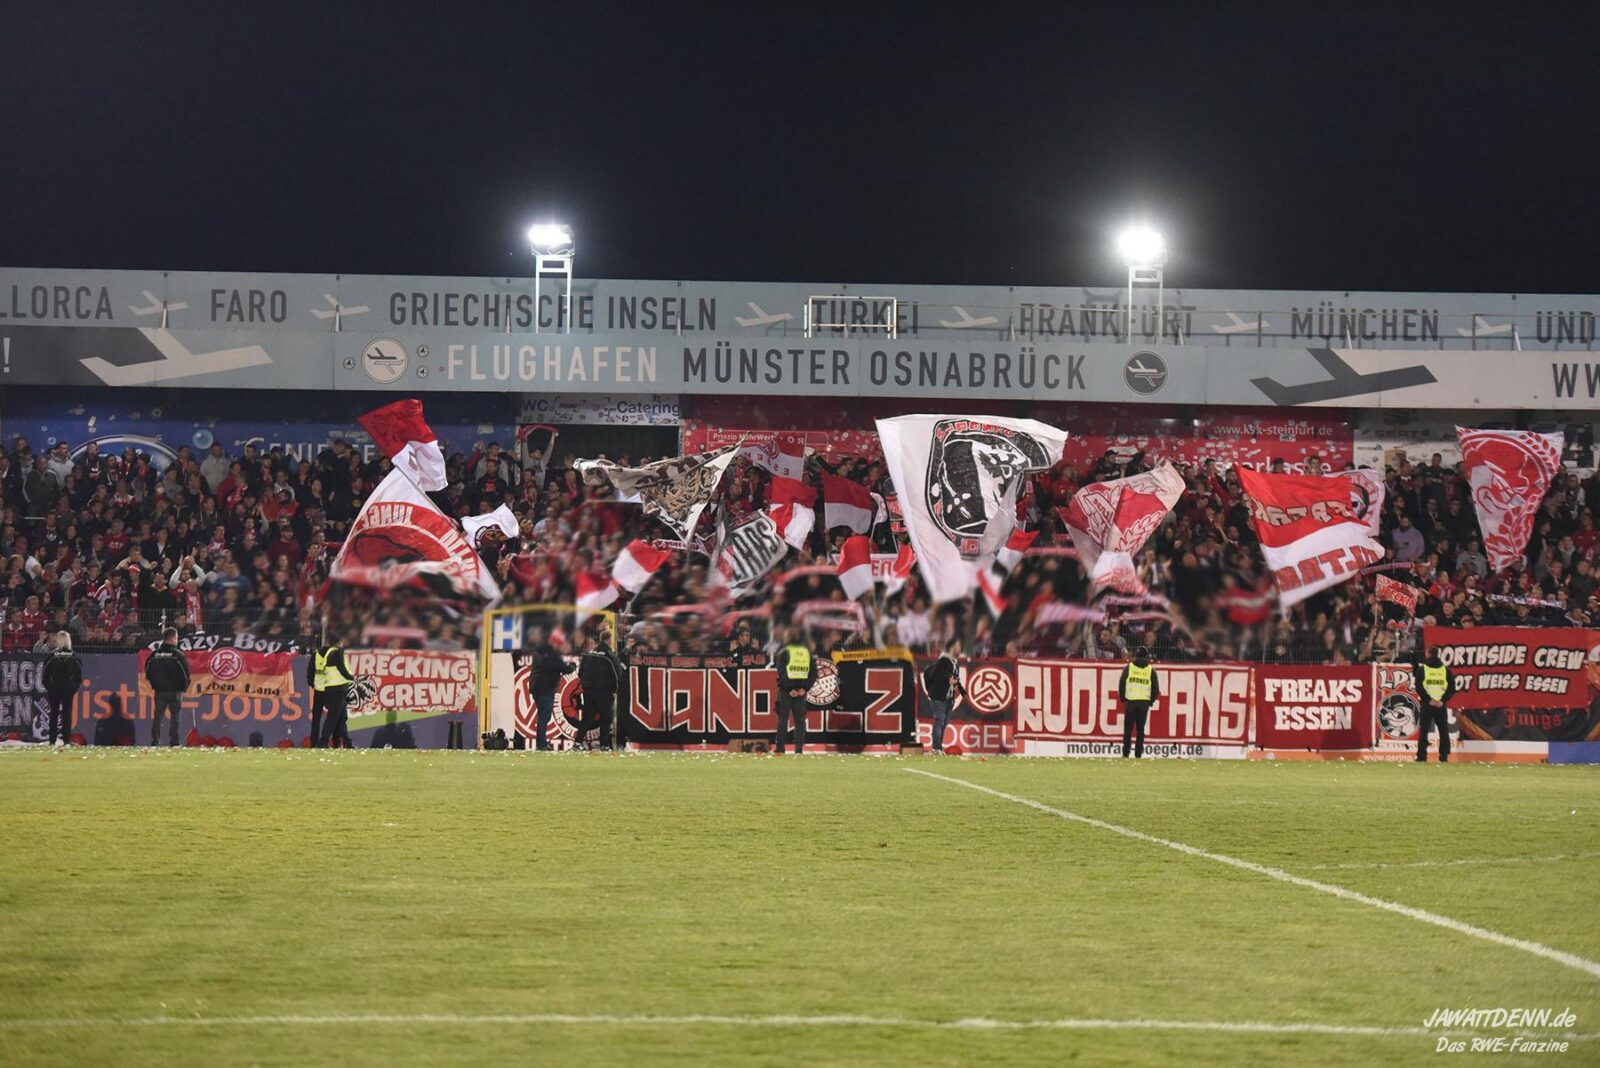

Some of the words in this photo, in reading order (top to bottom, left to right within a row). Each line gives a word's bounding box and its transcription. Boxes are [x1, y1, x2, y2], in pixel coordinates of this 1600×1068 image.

[0, 285, 113, 320] LORCA
[209, 288, 288, 323] FARO
[389, 292, 594, 329] GRIECHISCHE
[608, 296, 716, 331] INSELN
[1020, 303, 1197, 337] FRANKFURT
[1291, 301, 1438, 341] MÜNCHEN
[447, 344, 657, 382] FLUGHAFEN
[683, 341, 850, 385] MÜNSTER
[870, 347, 1087, 390] OSNABRÜCK
[522, 400, 548, 412] WC
[616, 400, 681, 417] Catering
[1213, 424, 1334, 437] www.ksk-steinfurtde
[1438, 645, 1527, 667] ORTHSIDE
[1534, 648, 1586, 669] CREW
[379, 682, 455, 708] CREW
[1264, 678, 1363, 703] FREAKS
[1478, 673, 1520, 690] WEISS
[1524, 677, 1569, 694] ESSEN
[1018, 665, 1125, 735] RUDE
[1274, 706, 1353, 731] ESSEN
